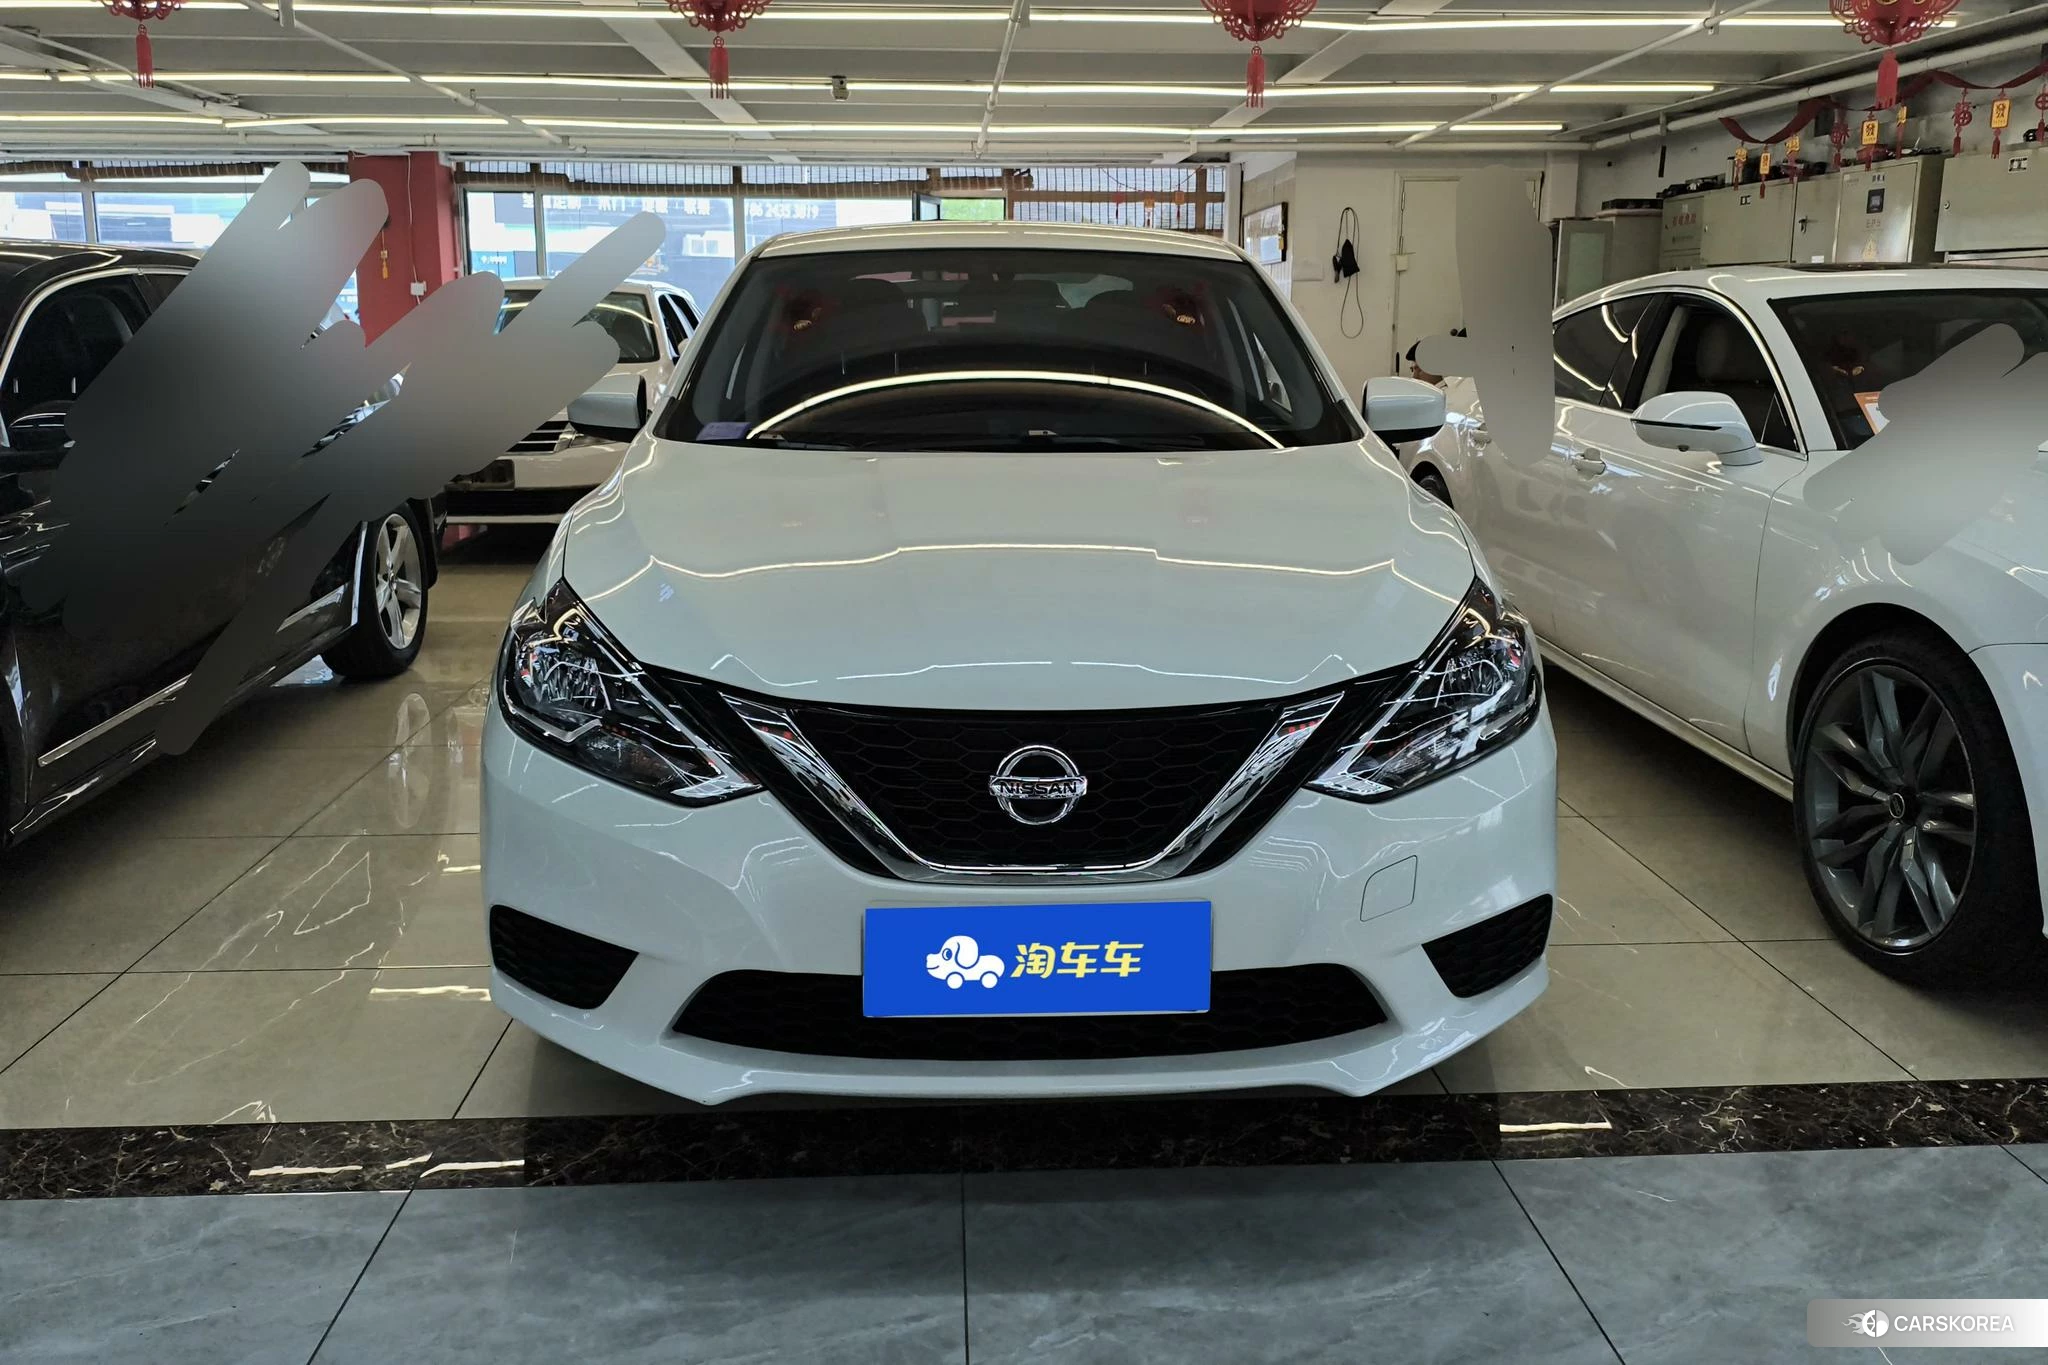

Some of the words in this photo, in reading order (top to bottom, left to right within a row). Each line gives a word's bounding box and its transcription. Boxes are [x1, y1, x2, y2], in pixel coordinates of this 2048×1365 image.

[999, 780, 1078, 796] NISSAN
[1010, 940, 1144, 978] 淘车车
